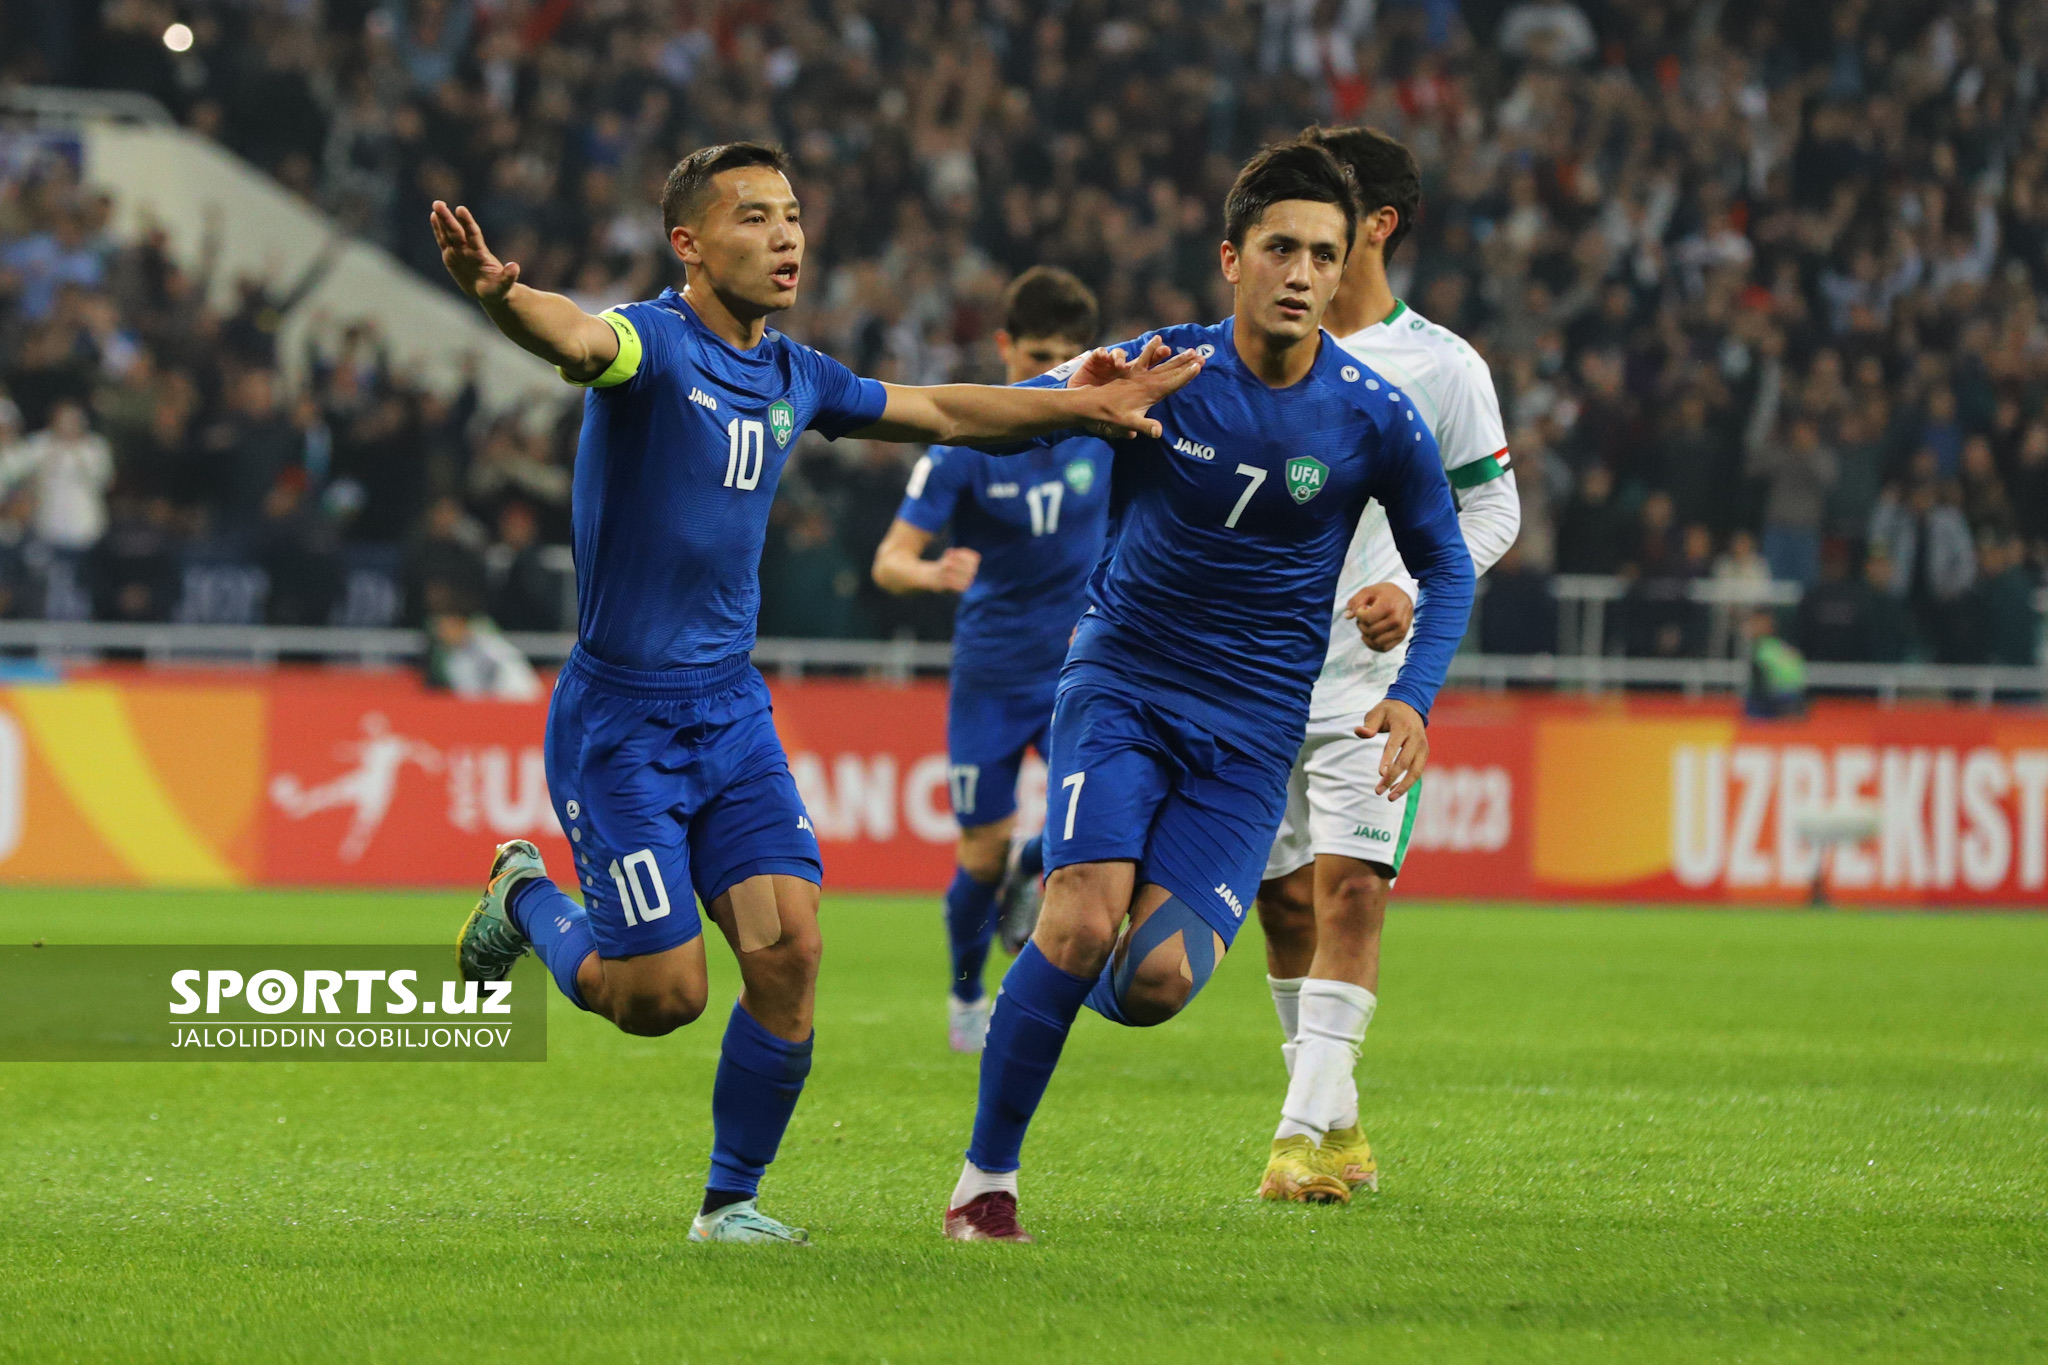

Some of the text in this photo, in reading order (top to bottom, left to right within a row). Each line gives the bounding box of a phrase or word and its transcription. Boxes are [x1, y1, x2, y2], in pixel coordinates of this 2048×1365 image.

[688, 387, 717, 411] JAKO
[772, 409, 791, 427] UFA
[723, 418, 764, 491] 10
[1173, 437, 1215, 460] JAKO
[1291, 464, 1320, 486] UFA
[1026, 481, 1064, 537] 17
[1224, 463, 1268, 529] 7
[1062, 771, 1085, 840] 7
[1353, 825, 1391, 843] JAKO
[608, 848, 671, 928] 10
[1214, 883, 1244, 918] JAKO
